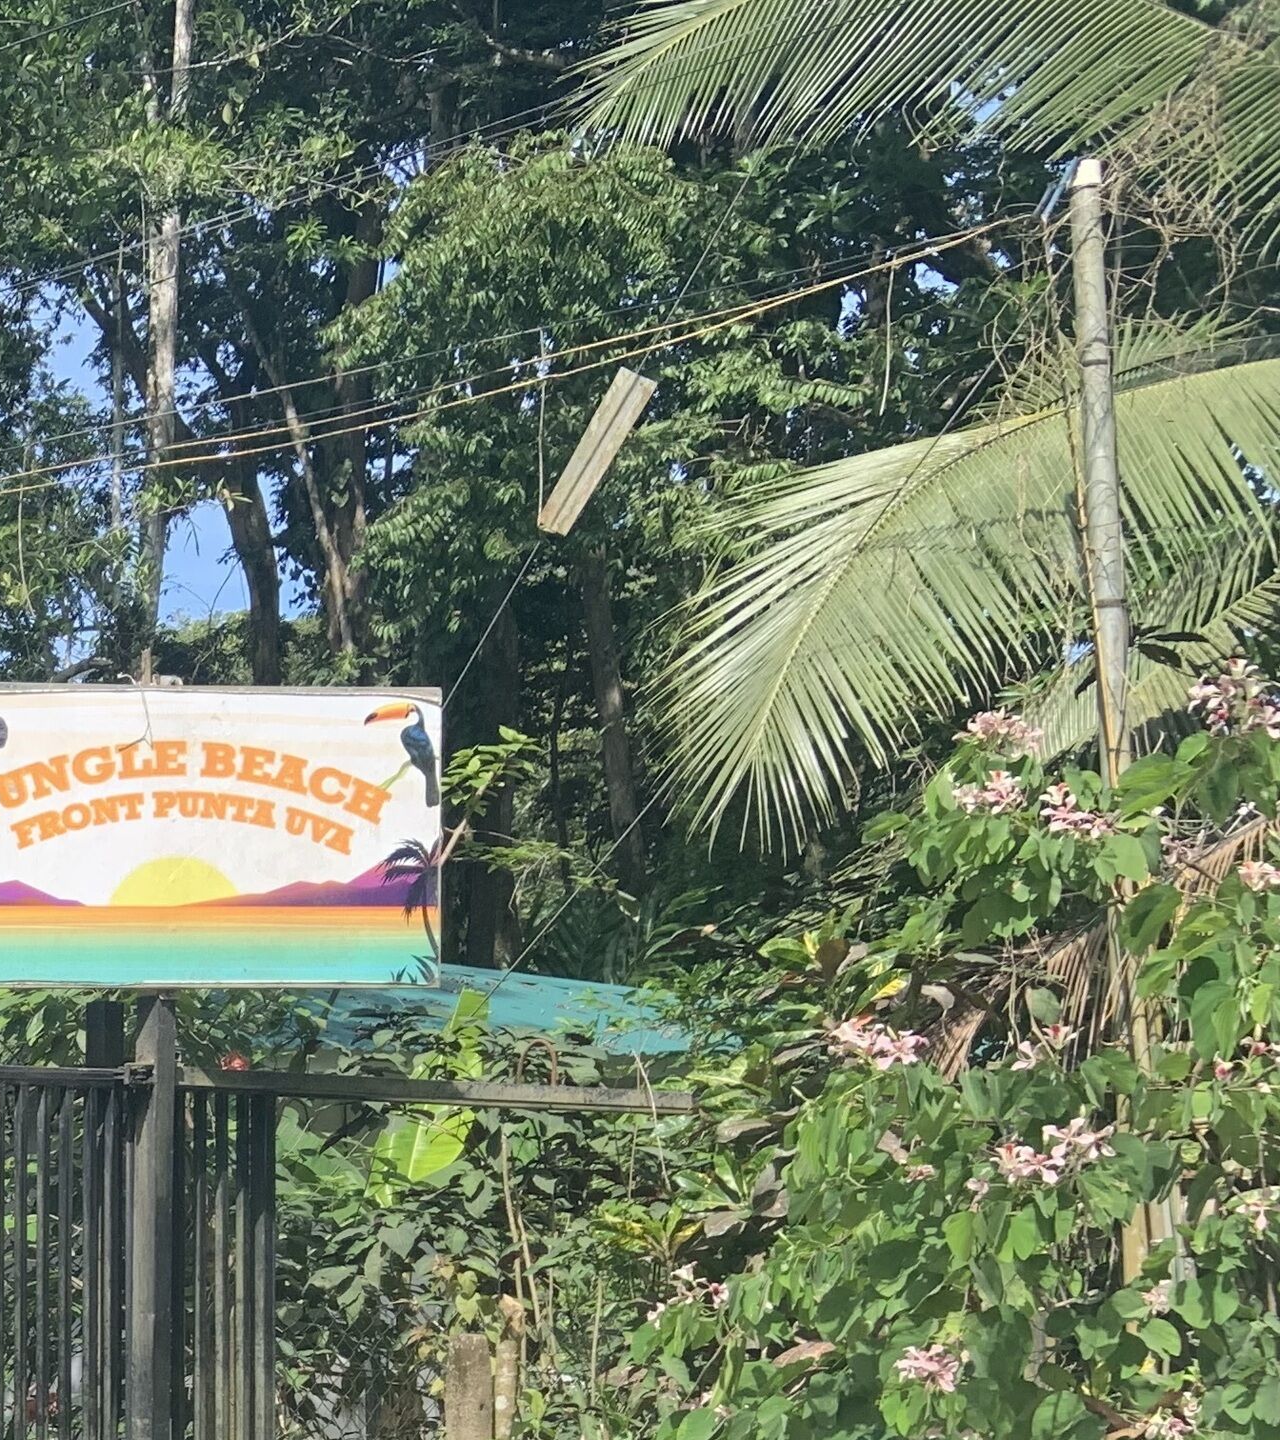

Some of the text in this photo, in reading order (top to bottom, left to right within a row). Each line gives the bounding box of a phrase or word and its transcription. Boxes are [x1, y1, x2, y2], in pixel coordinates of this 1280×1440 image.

[200, 742, 392, 824] BEACH
[10, 791, 353, 855] FRONT PUNTA UVA
